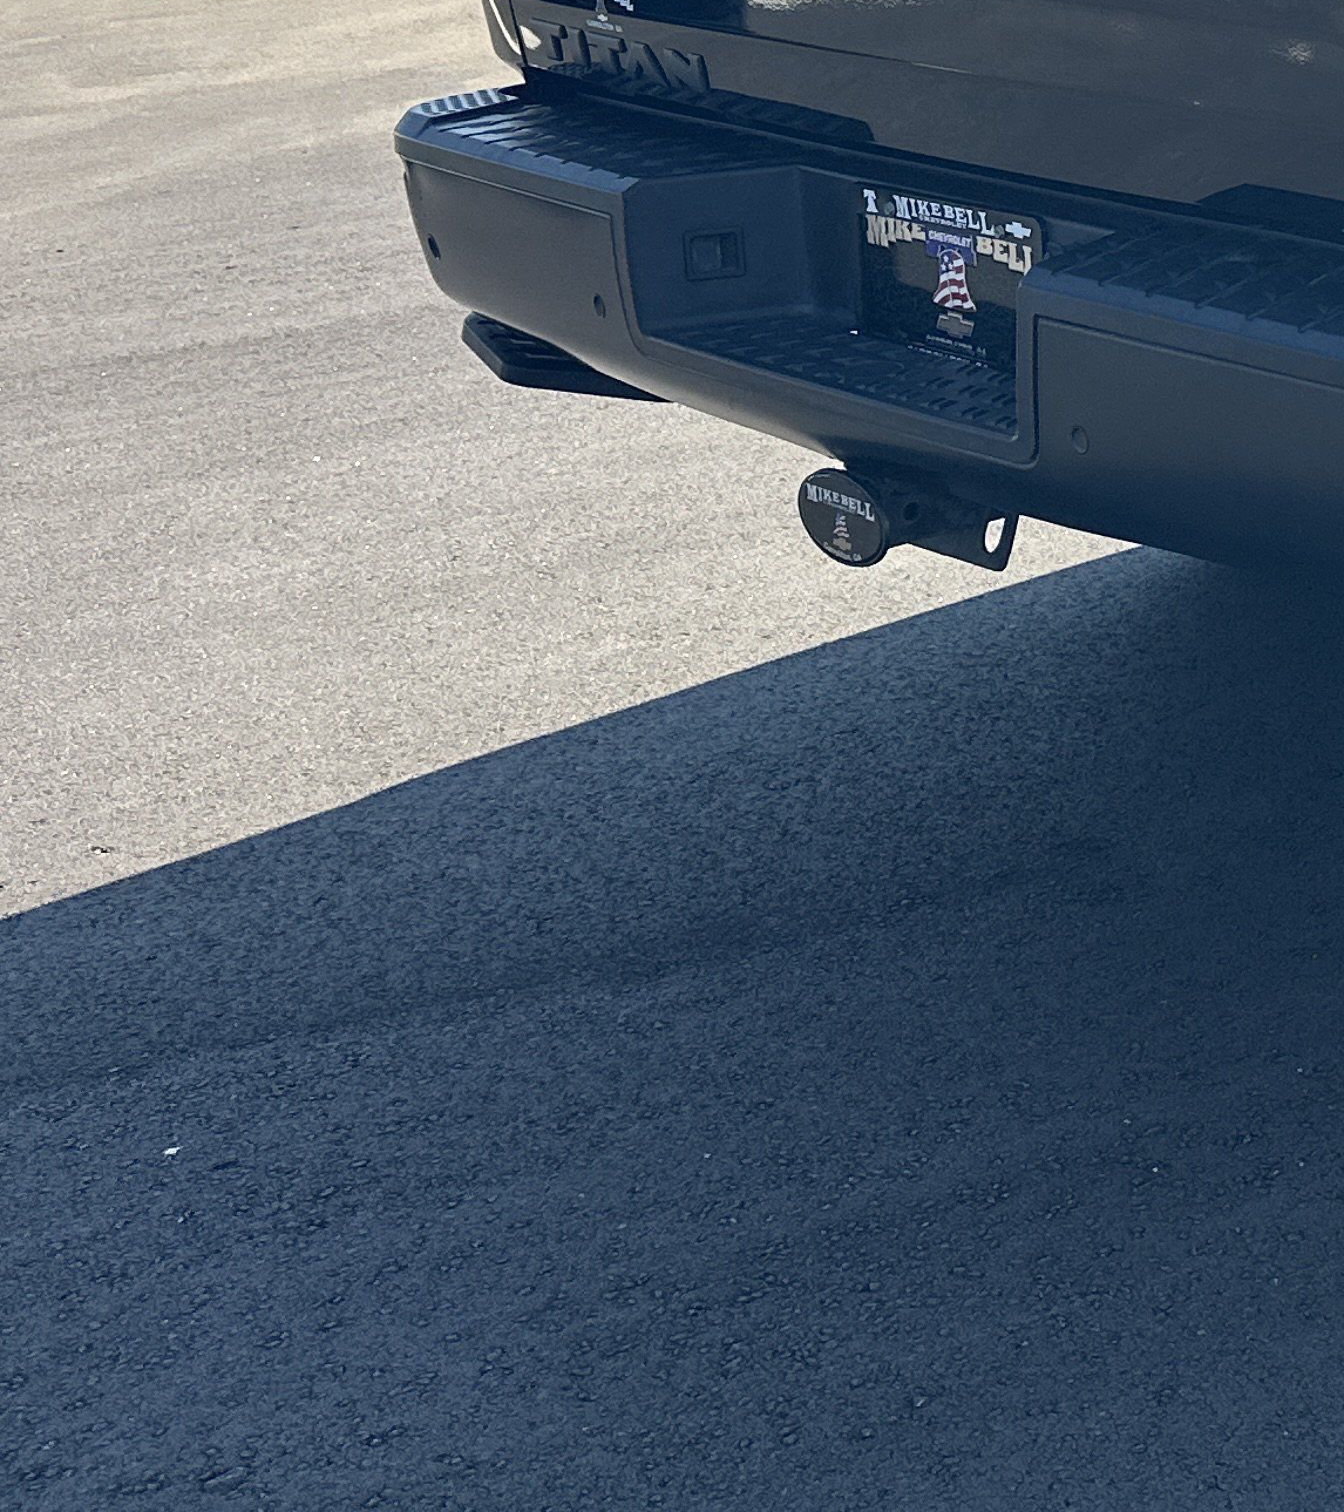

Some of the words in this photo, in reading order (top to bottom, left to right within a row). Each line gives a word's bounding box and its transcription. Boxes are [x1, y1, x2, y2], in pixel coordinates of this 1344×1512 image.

[530, 16, 712, 89] TITAN
[865, 214, 926, 248] MIKE
[892, 194, 941, 220] MIKE
[942, 204, 996, 237] BELL
[928, 229, 973, 248] CHEVROLET
[806, 482, 840, 503] MIKE
[840, 494, 876, 522] BELL
